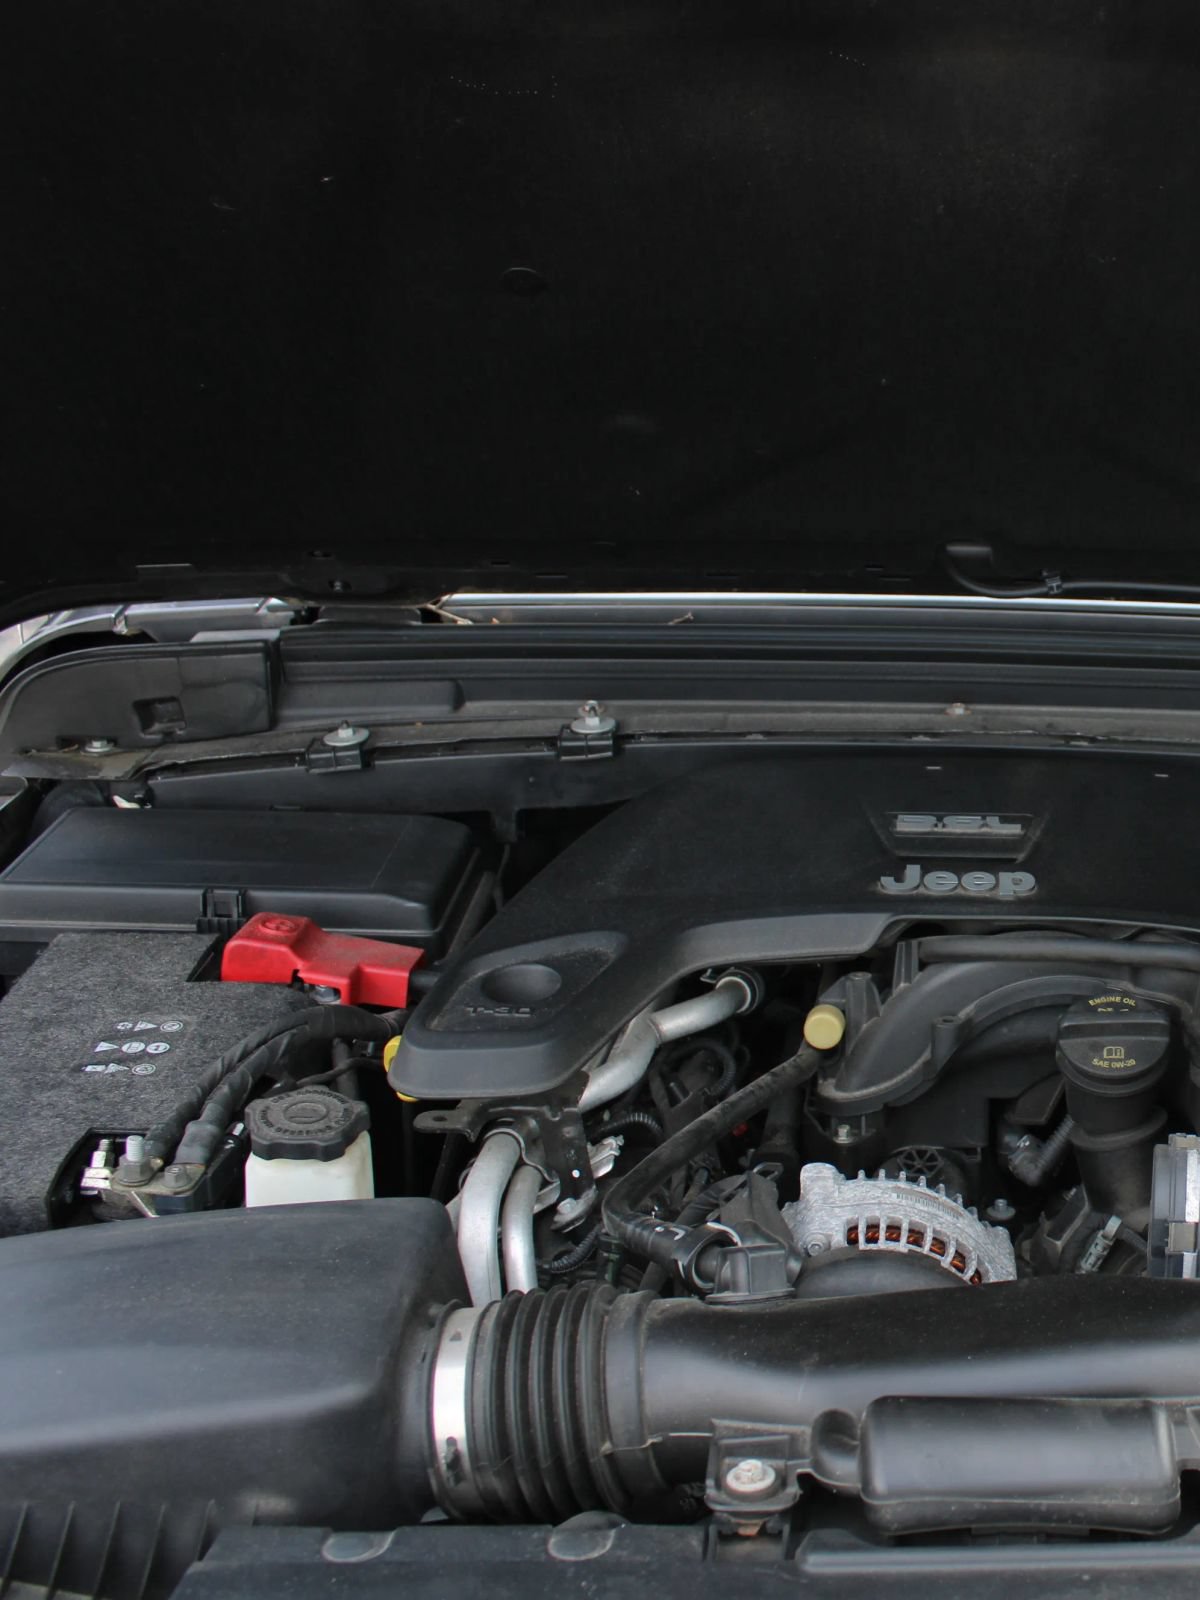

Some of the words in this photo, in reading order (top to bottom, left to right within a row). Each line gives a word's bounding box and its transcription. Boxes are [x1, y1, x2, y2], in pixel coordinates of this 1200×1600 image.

[896, 814, 1023, 832] 3.6L
[879, 864, 1037, 900] Jeep
[1088, 996, 1122, 1007] ENGINE
[1123, 997, 1136, 1007] OIL
[1092, 1058, 1110, 1069] SAE
